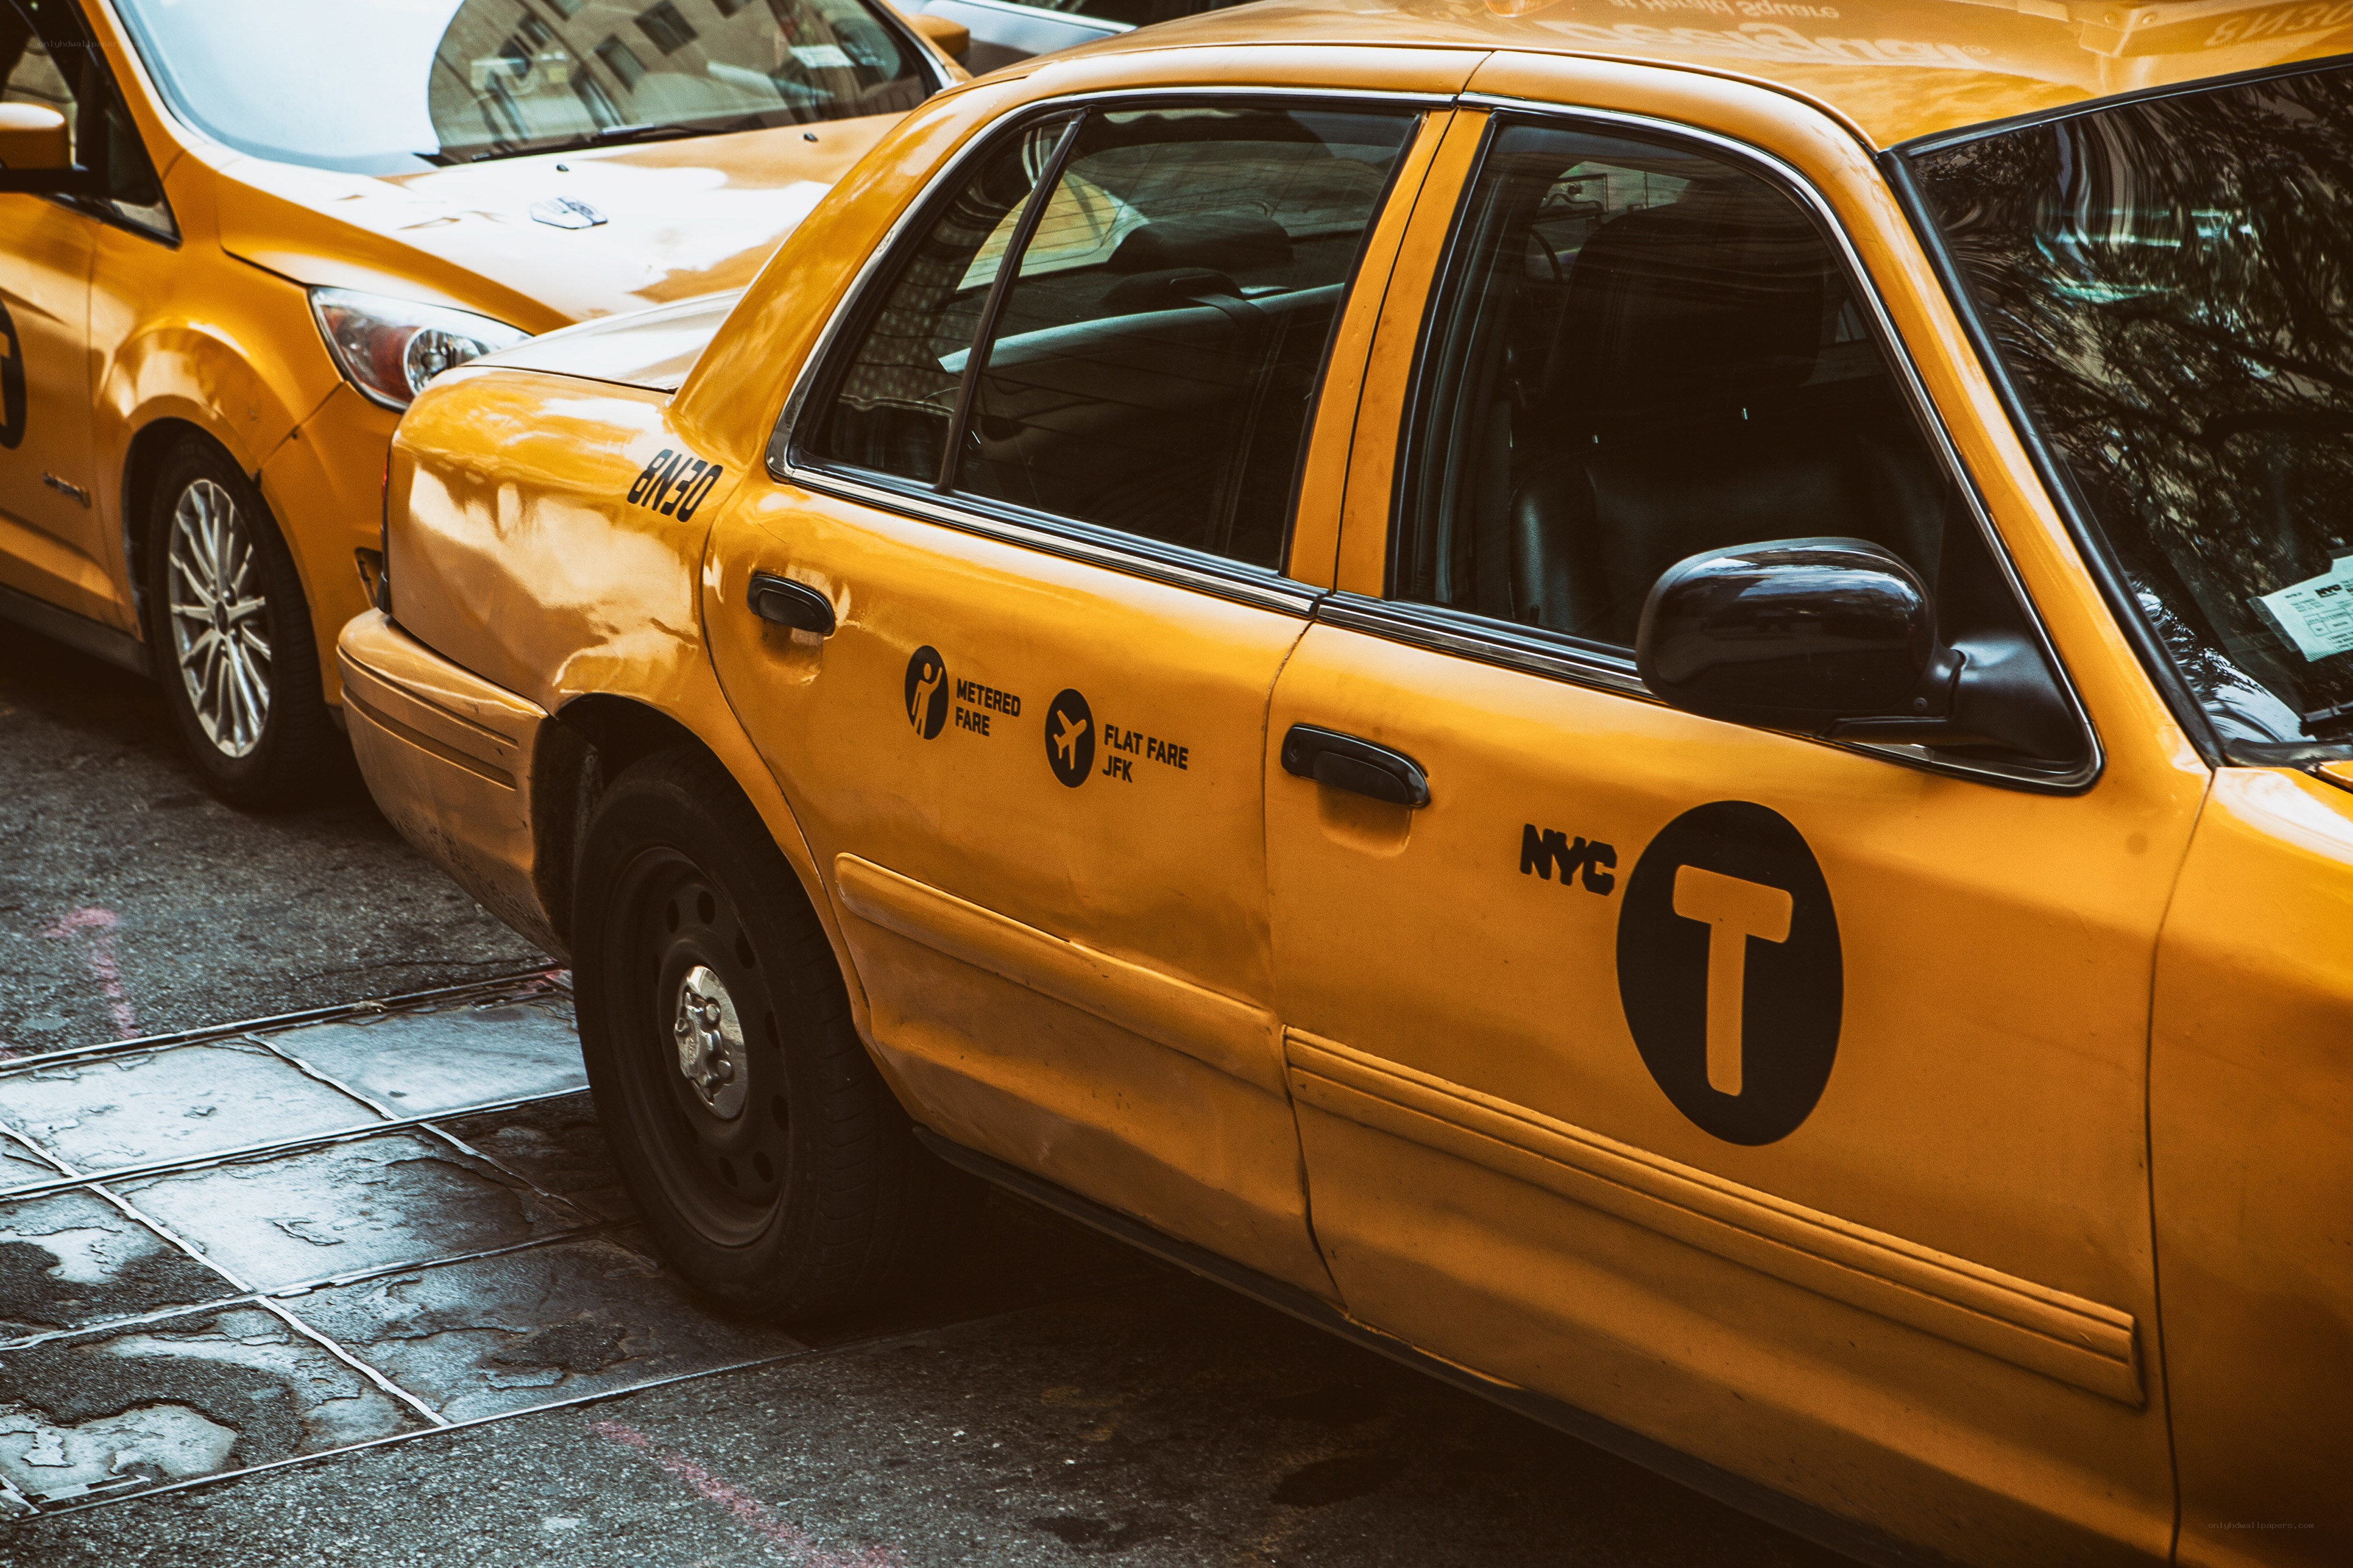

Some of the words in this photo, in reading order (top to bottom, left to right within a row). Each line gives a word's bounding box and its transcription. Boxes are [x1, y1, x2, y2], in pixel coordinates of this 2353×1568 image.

[627, 449, 724, 522] 8N30
[956, 678, 1021, 717] METERED
[955, 706, 990, 737] FARE
[1104, 724, 1144, 755] FLAT
[1146, 736, 1189, 770] FARE
[1102, 755, 1133, 783] JFK
[1520, 823, 1618, 897] NYC
[1672, 864, 1793, 1097] T
